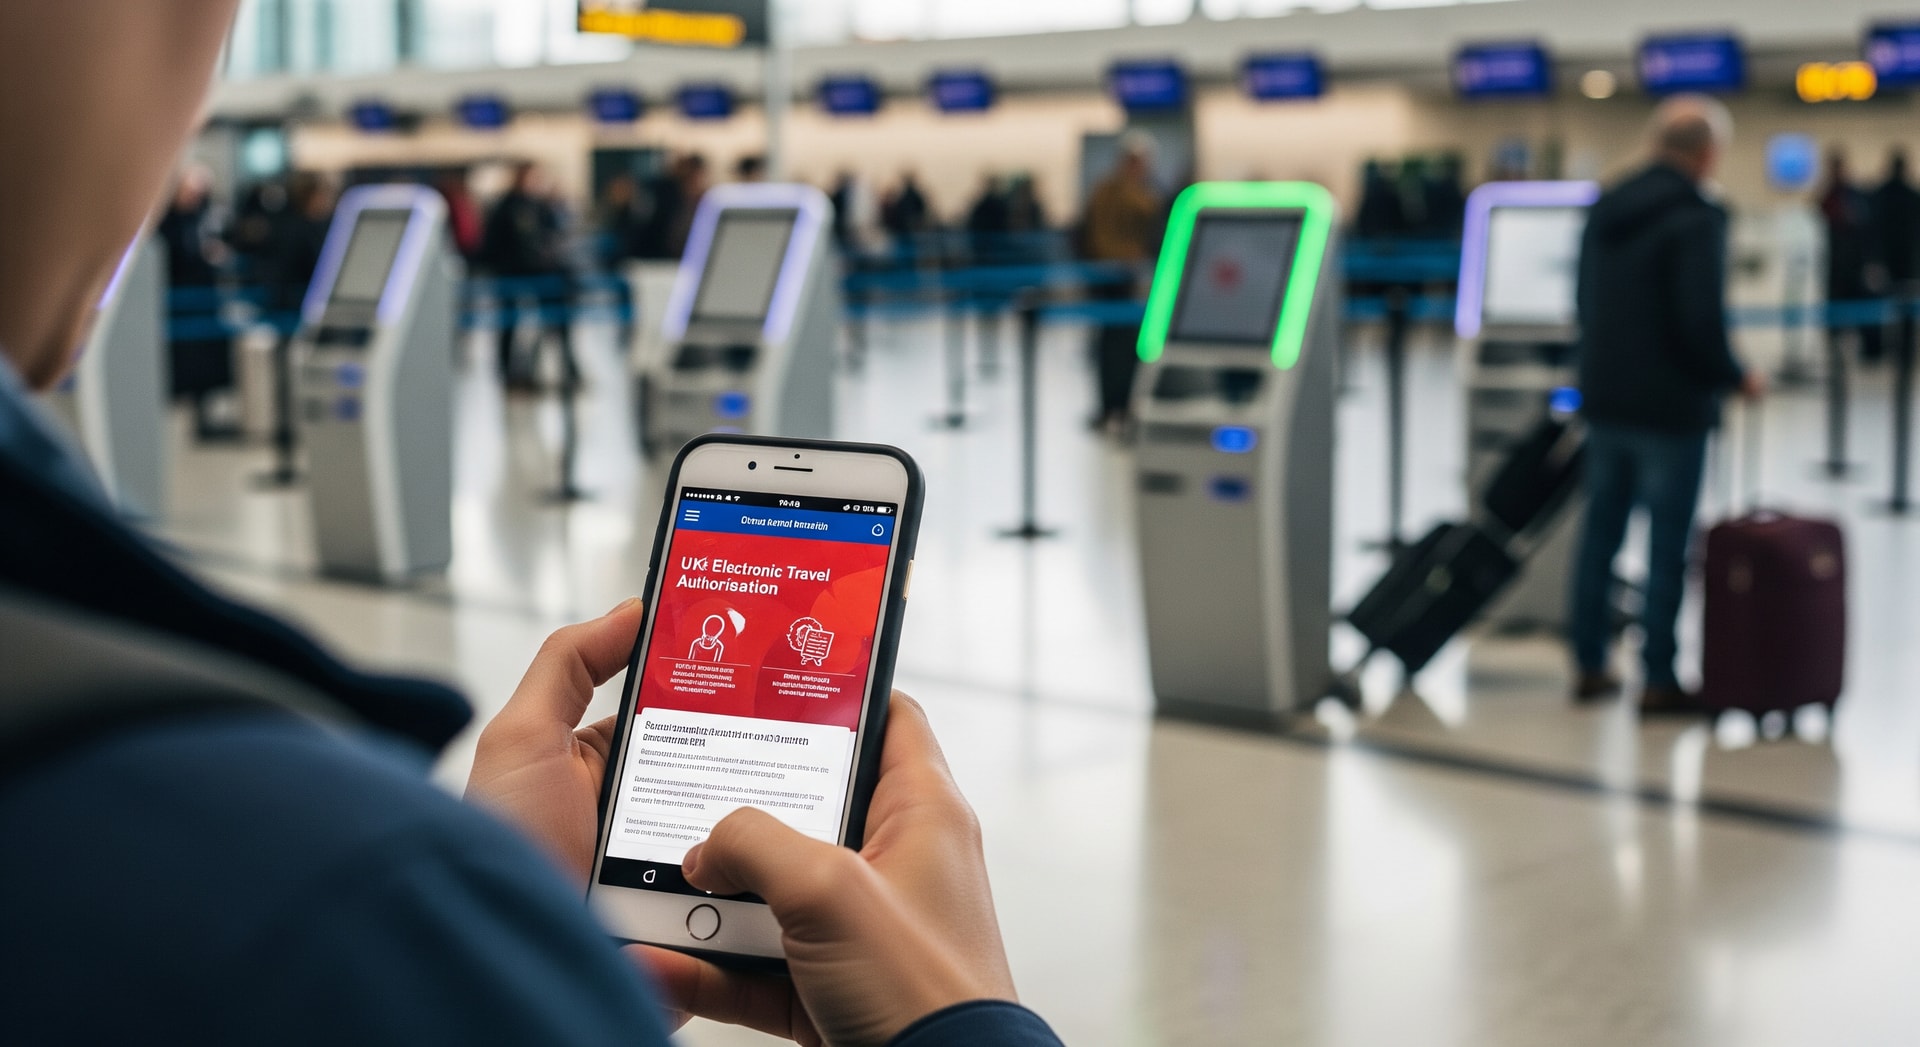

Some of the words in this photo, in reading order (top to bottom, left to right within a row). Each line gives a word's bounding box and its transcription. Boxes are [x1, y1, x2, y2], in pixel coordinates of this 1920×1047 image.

[712, 559, 783, 578] Electronic
[787, 565, 831, 582] Travel
[676, 574, 779, 596] Authorisation
